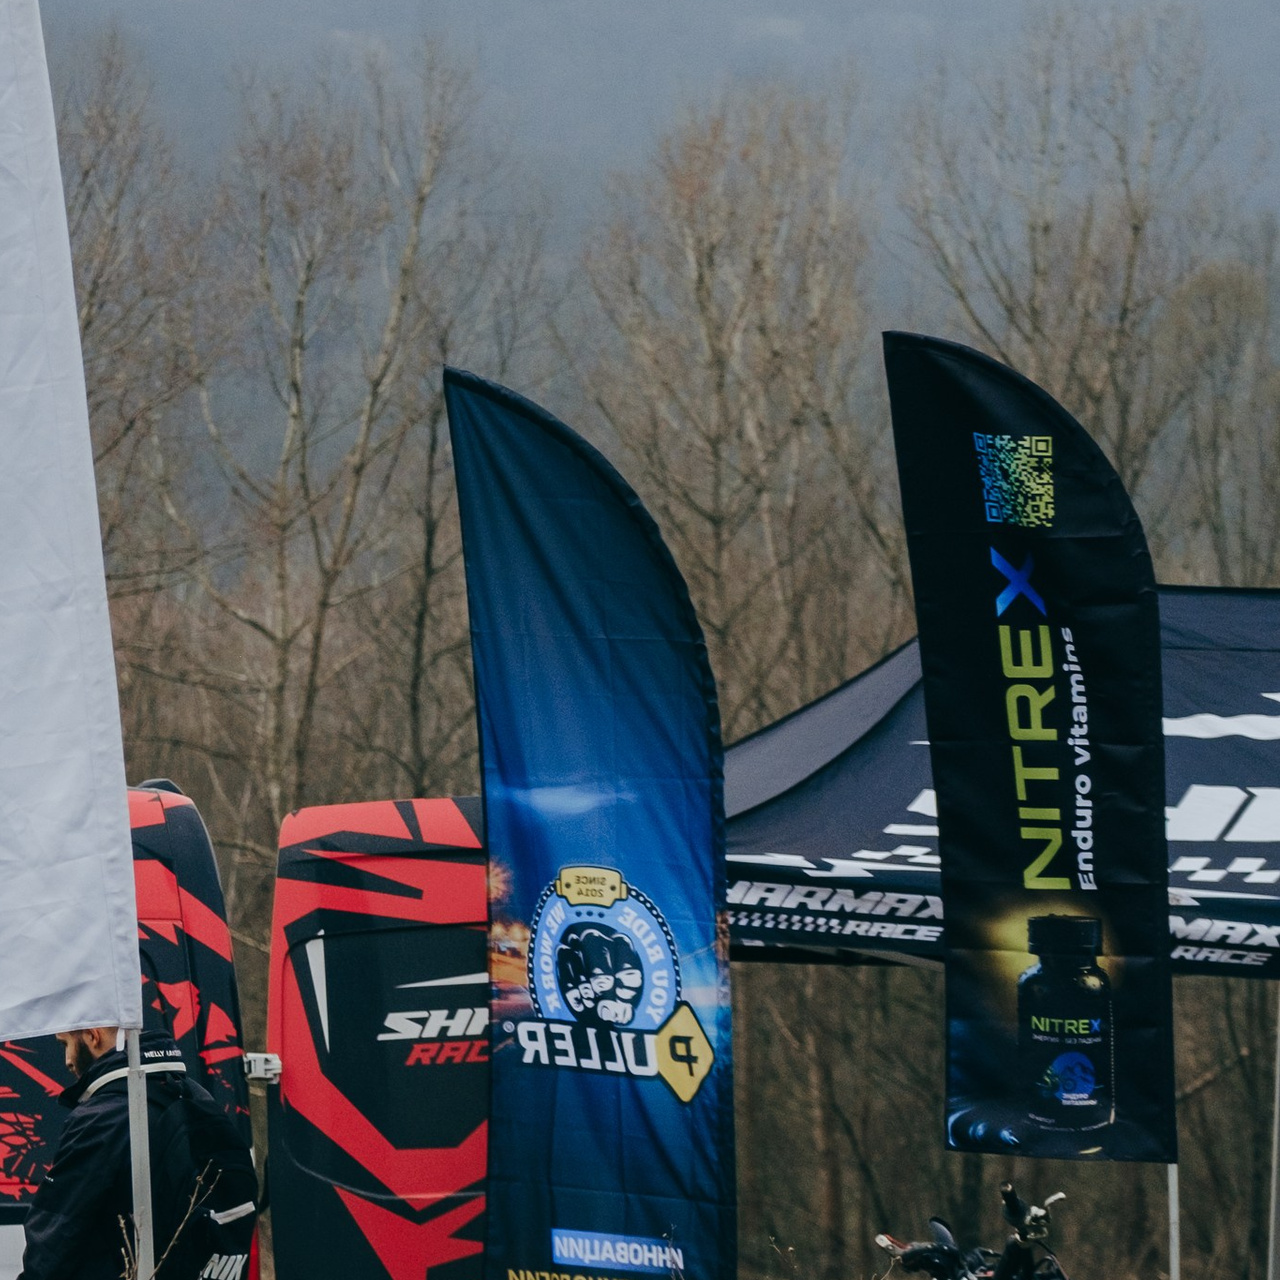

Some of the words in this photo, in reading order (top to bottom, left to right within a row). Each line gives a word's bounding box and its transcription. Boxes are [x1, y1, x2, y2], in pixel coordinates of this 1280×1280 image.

[990, 546, 1072, 890] NITREX
[1061, 626, 1093, 766] vitamins
[1070, 774, 1098, 891] Enduro
[842, 920, 944, 942] RACE
[1170, 945, 1272, 965] RACE
[1030, 1015, 1102, 1035] NITREX
